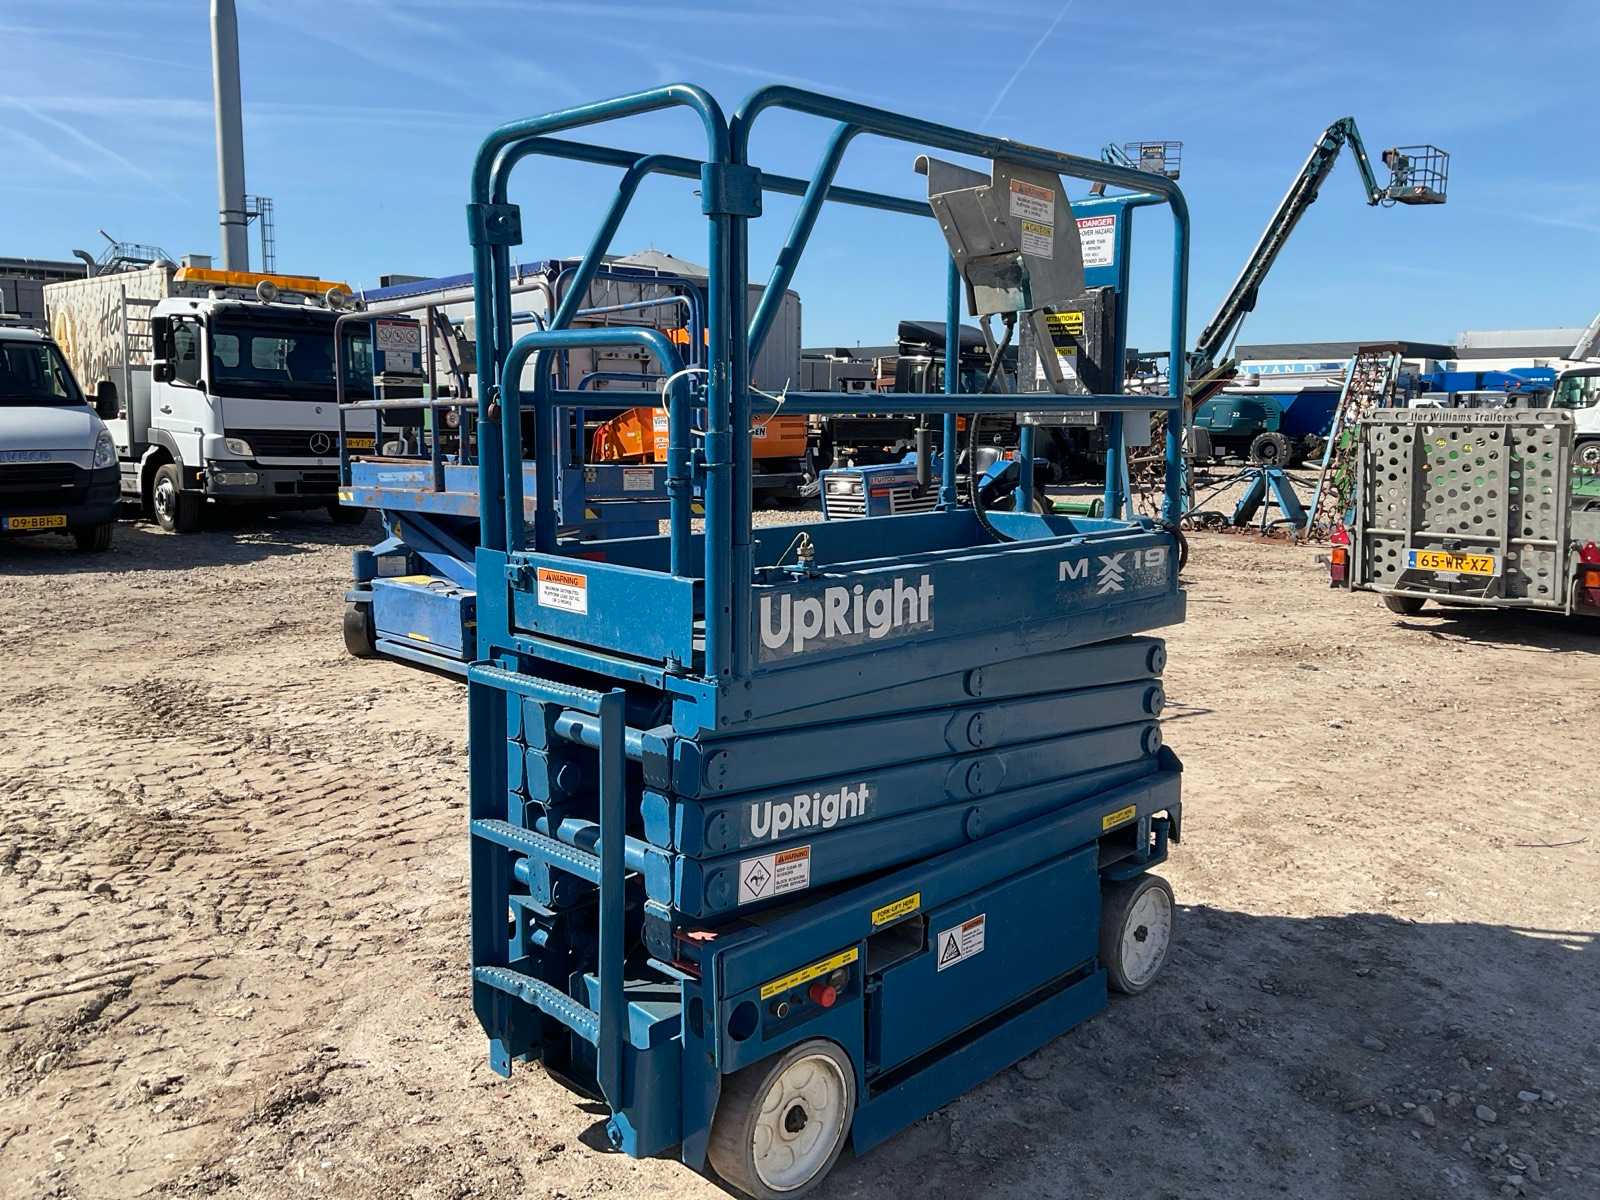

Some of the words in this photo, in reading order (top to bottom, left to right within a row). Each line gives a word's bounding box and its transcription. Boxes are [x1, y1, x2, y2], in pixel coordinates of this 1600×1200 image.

[1082, 218, 1113, 227] DANGER
[1095, 227, 1113, 235] HAZARD
[1258, 365, 1295, 374] VAN
[1411, 411, 1427, 421] Ifor
[1430, 411, 1472, 422] Williams
[1475, 411, 1514, 422] Trailers
[12, 517, 64, 528] 09-BBH-3
[1421, 555, 1489, 571] 65-WR-XZ
[552, 573, 578, 585] WARNING
[760, 574, 934, 652] UpRight
[751, 782, 869, 839] UpRight
[878, 902, 902, 918] FORK-LIFT
